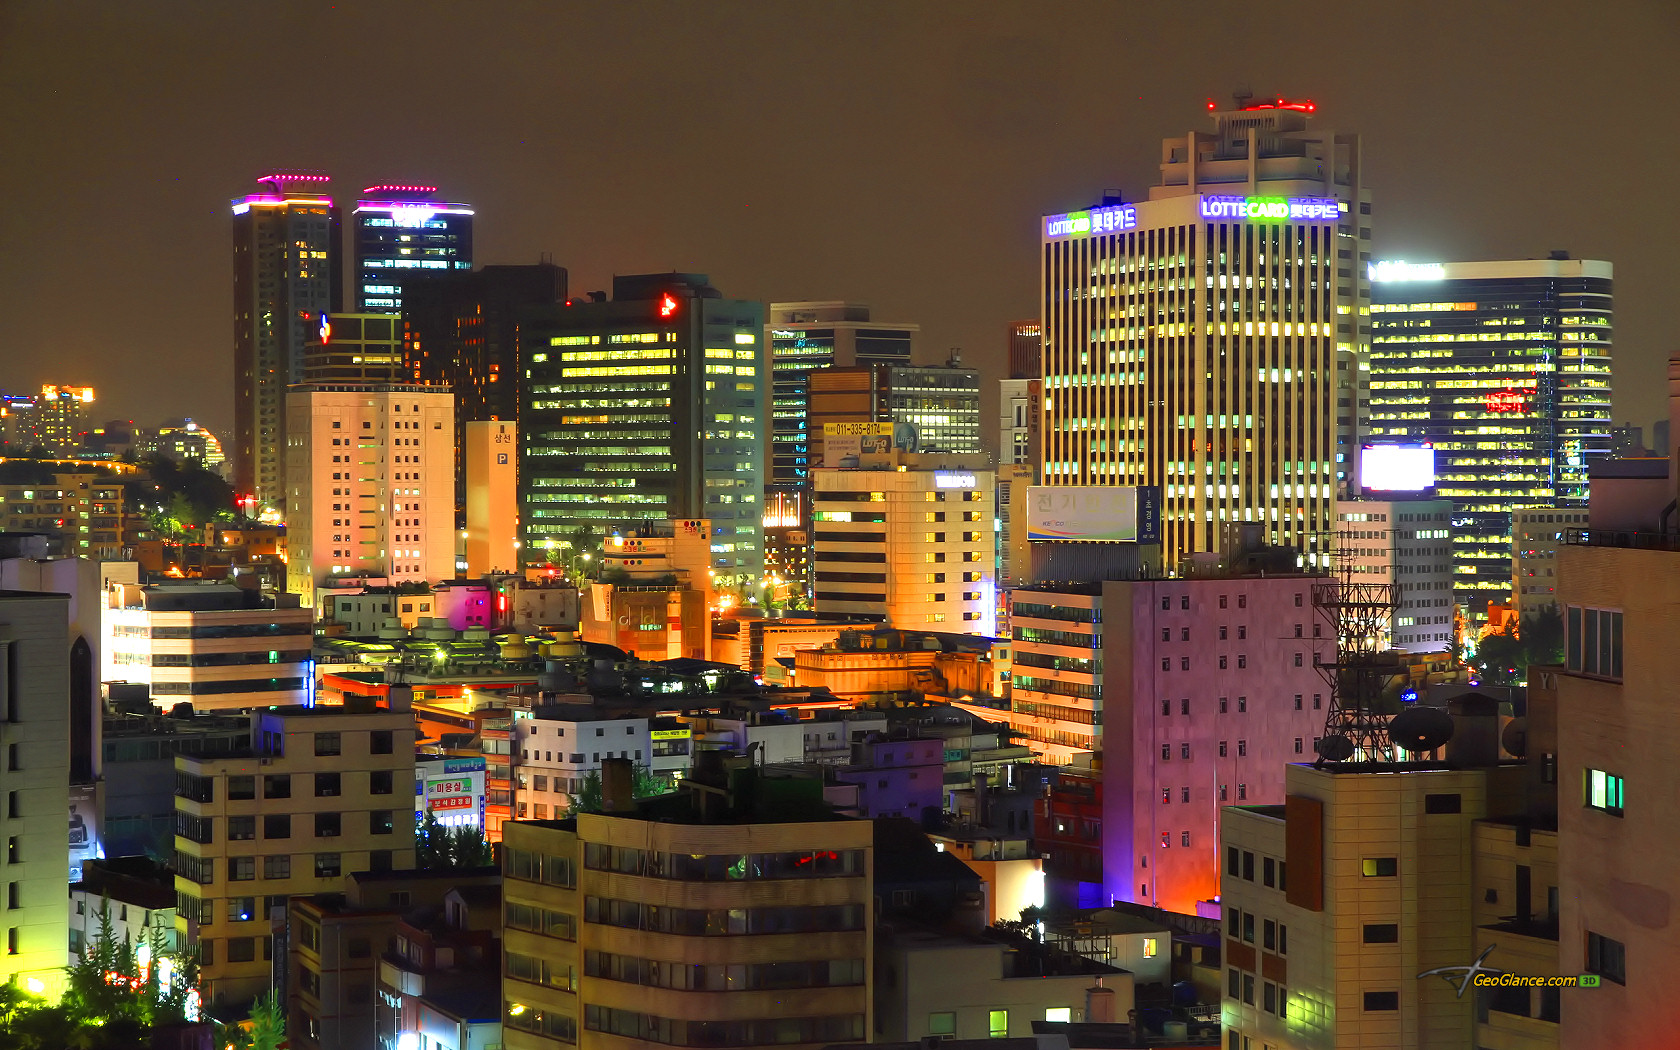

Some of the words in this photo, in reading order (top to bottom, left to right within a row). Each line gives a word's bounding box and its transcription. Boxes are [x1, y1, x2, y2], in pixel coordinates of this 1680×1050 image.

[1290, 204, 1339, 218] 롯데카드
[1092, 208, 1135, 232] 롯데카드
[437, 782, 461, 793] 미용실
